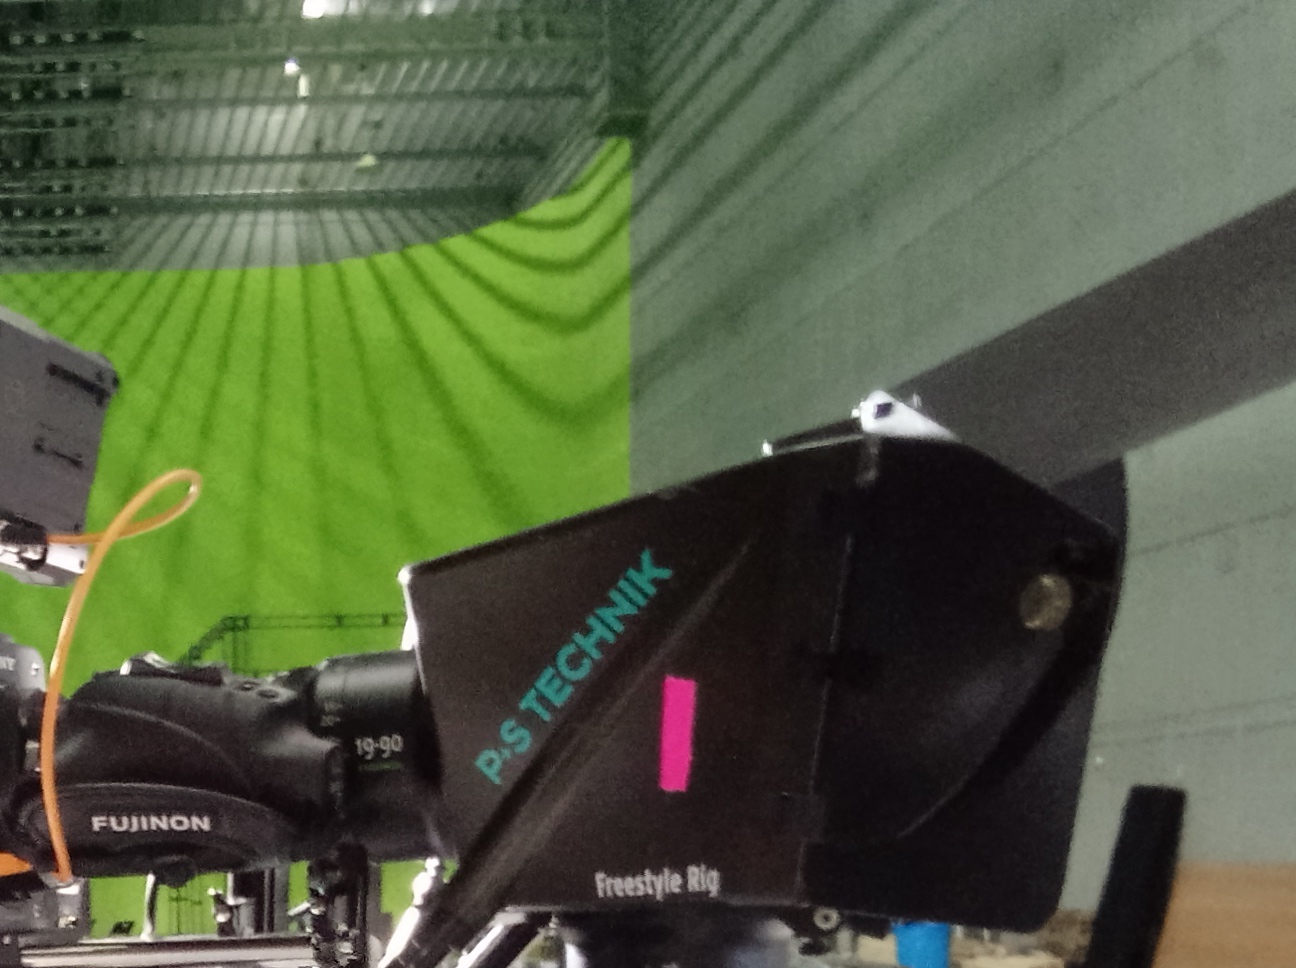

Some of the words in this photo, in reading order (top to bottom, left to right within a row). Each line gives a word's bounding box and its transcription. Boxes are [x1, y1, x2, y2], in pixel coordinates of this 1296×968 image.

[518, 548, 673, 723] TECHNIK
[90, 814, 211, 833] FUJINON
[594, 868, 683, 901] Freestyle
[686, 862, 721, 898] Rig
